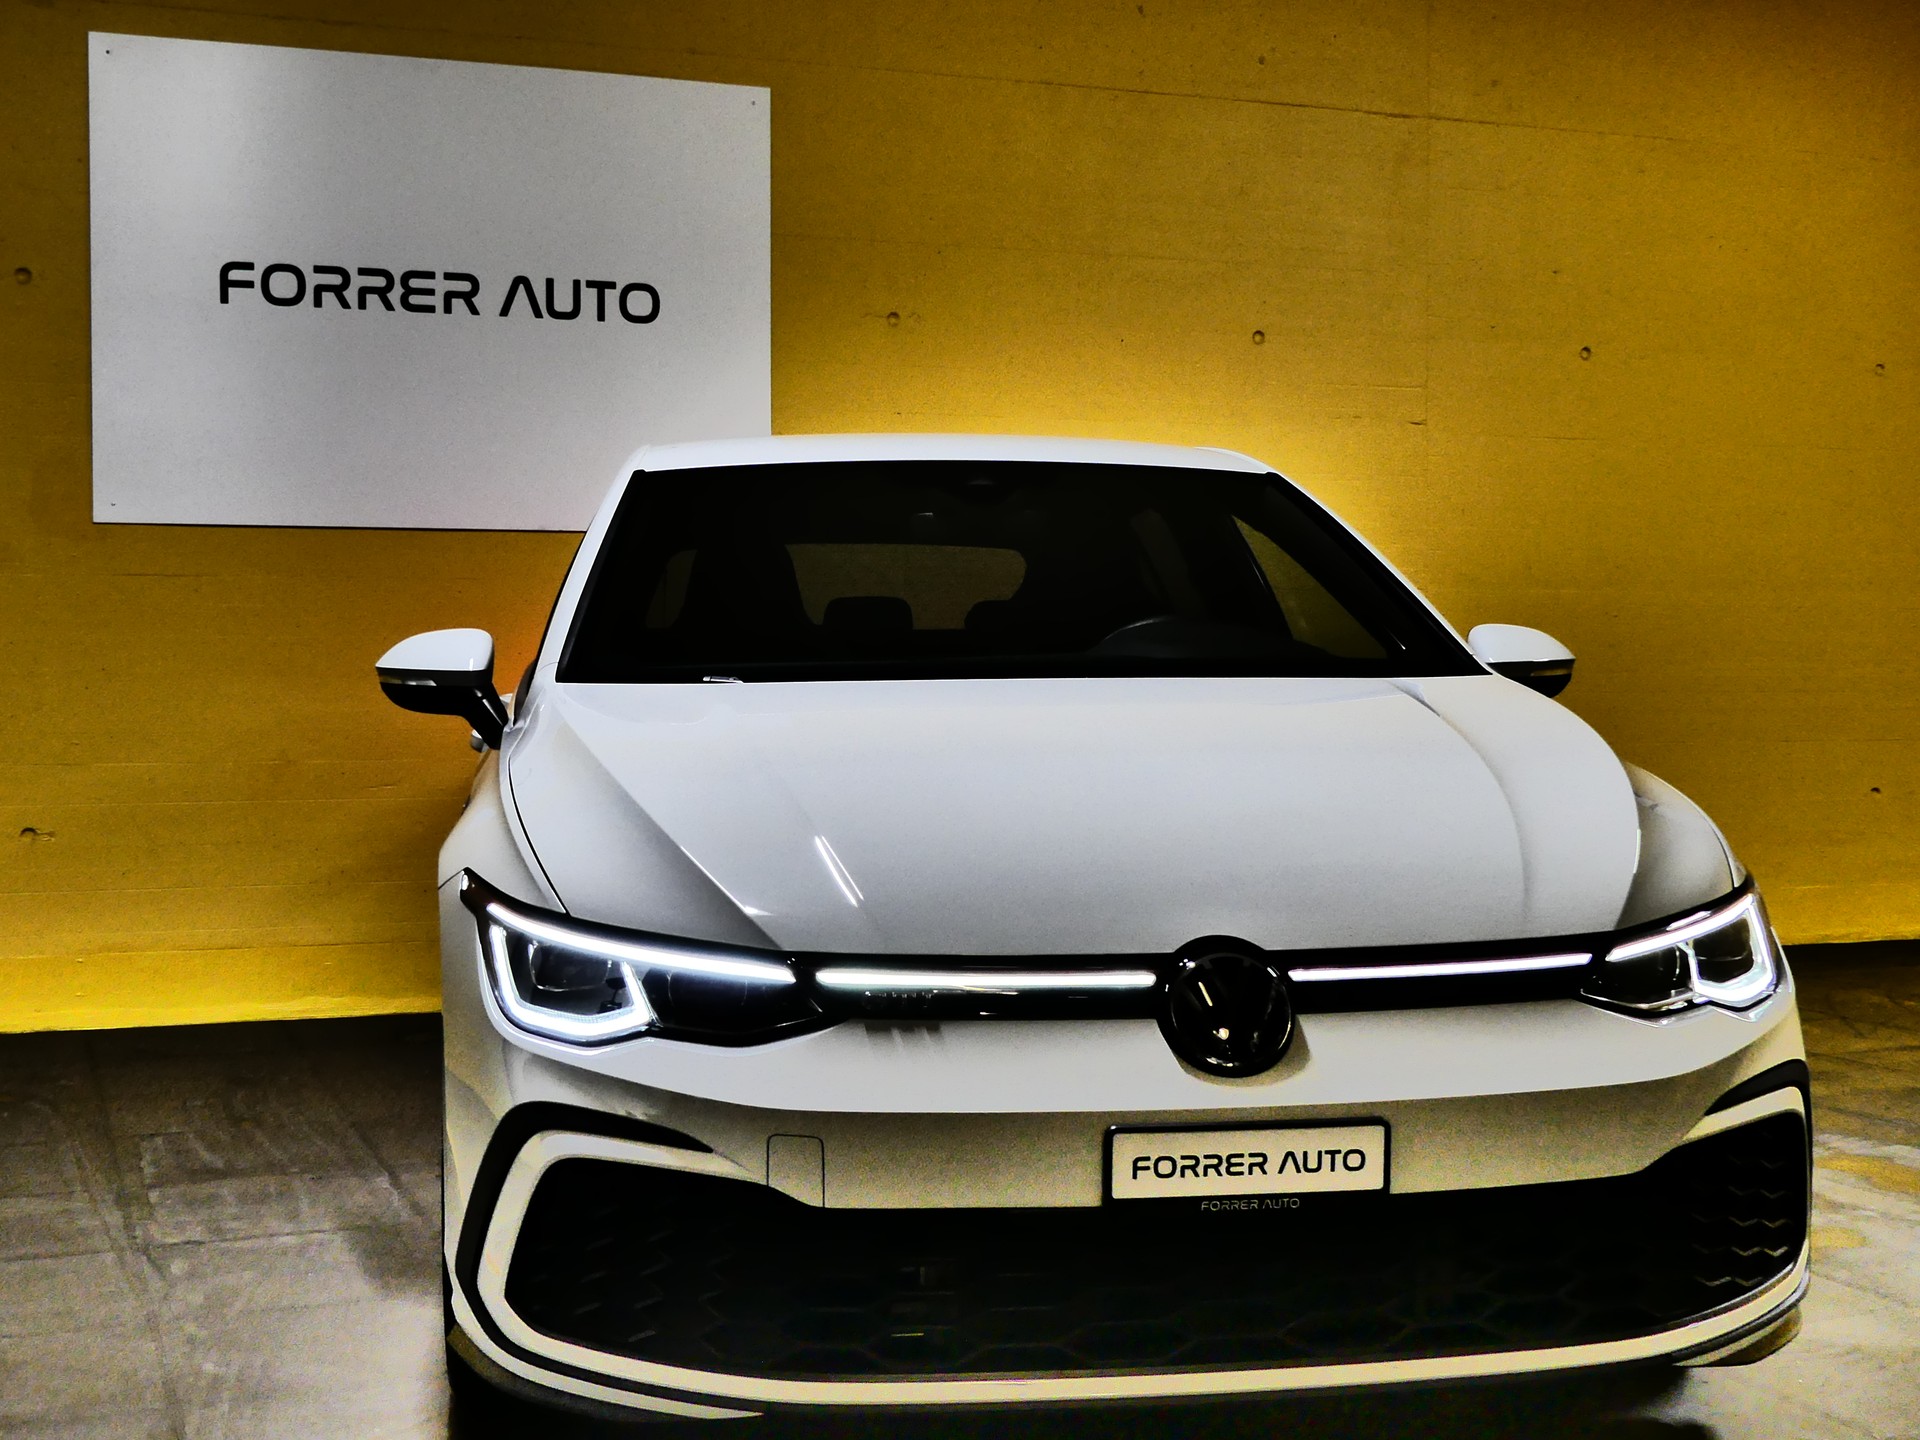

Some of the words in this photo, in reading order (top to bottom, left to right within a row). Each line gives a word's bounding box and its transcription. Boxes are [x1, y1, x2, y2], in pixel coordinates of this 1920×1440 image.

[219, 261, 480, 316] FORRER
[499, 275, 661, 324] AUTO
[1132, 1152, 1268, 1180] FORRER
[1277, 1148, 1366, 1175] AUTO
[1200, 1199, 1259, 1212] FORRER
[1262, 1197, 1300, 1210] AUTO
